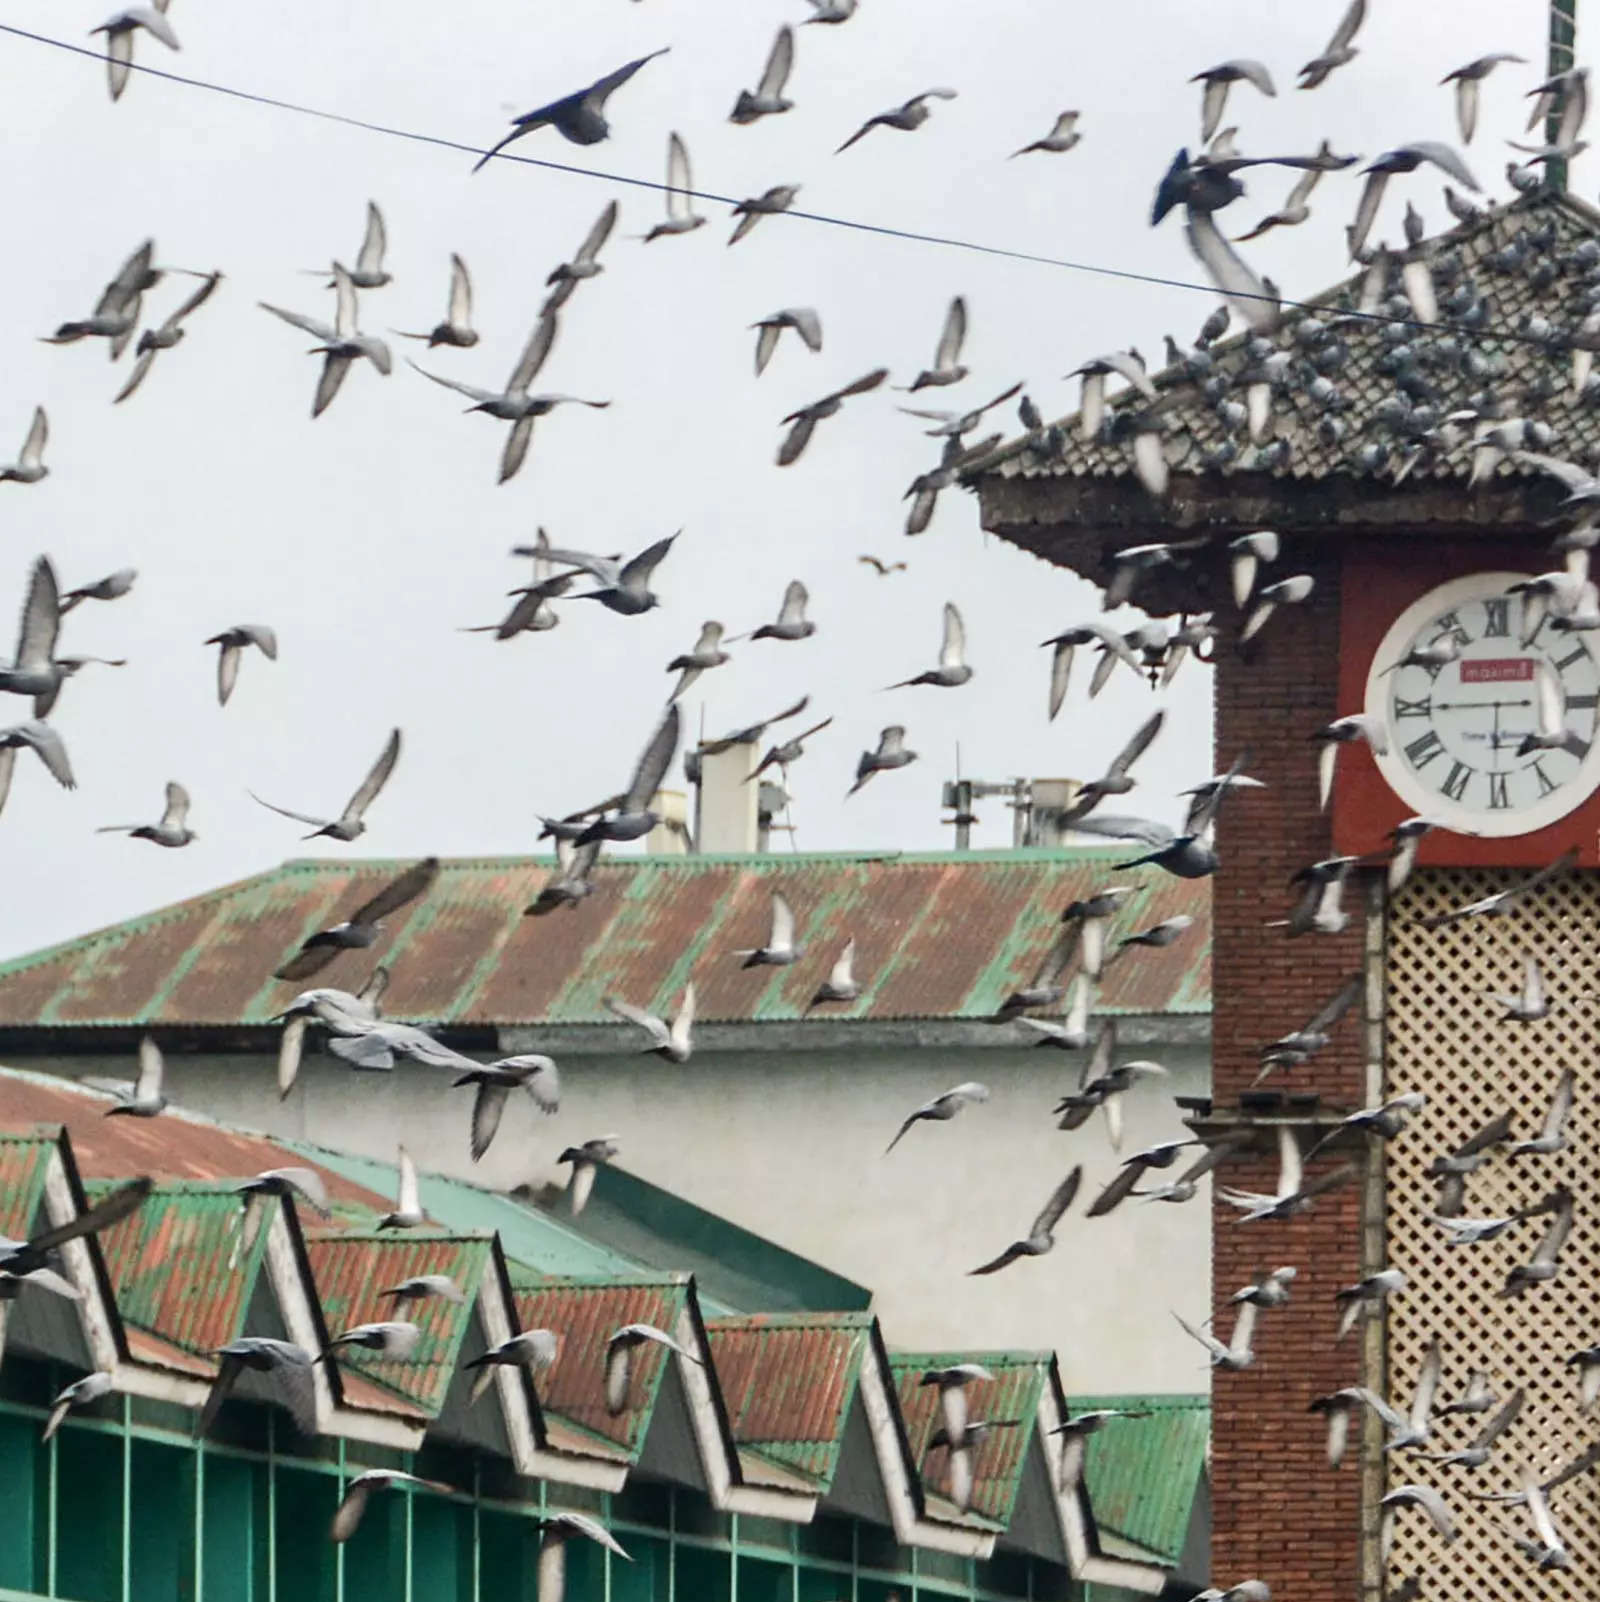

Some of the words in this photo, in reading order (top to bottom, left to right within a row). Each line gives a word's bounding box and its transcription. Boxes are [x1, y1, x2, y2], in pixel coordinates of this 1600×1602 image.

[1481, 598, 1512, 638] XII
[1394, 694, 1432, 721] IX
[1403, 729, 1448, 770] VIII
[1439, 759, 1480, 802] VII
[1485, 770, 1514, 810] VI
[1521, 753, 1563, 799] V
